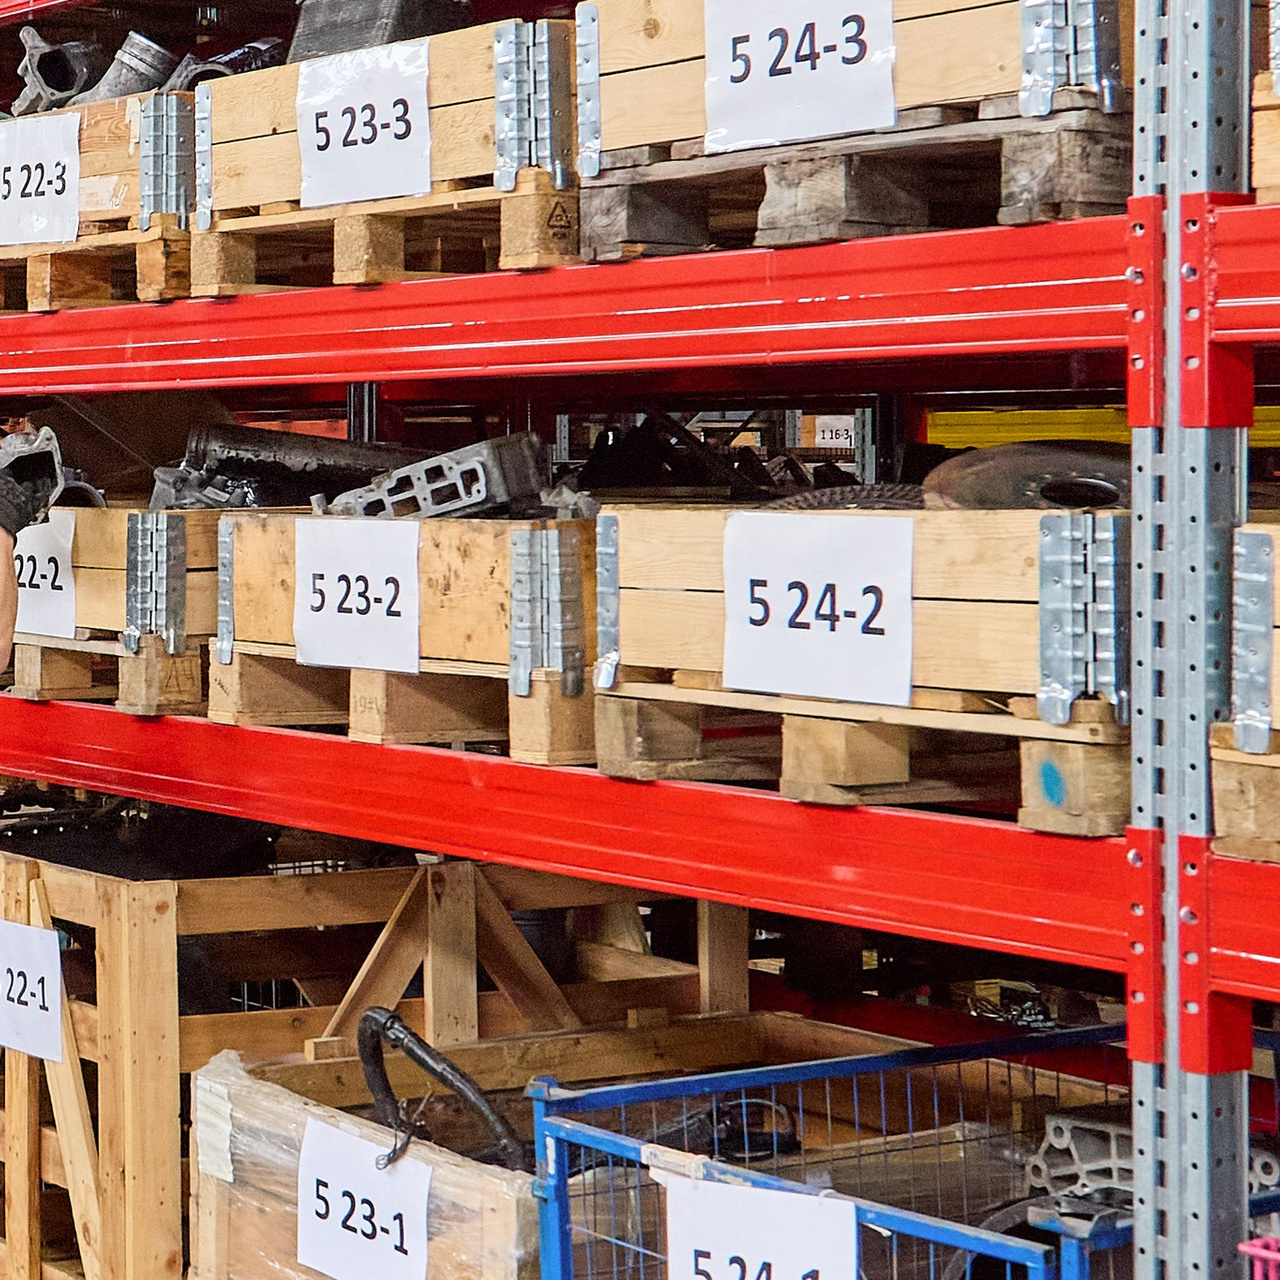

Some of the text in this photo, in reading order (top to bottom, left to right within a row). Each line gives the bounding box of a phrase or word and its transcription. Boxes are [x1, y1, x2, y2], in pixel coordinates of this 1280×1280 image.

[730, 14, 868, 84] 5 24-3
[315, 97, 412, 152] 5 23-3
[1, 161, 67, 201] 5 22-3
[14, 553, 64, 592] 22-2
[310, 573, 402, 618] 5 23-2
[749, 578, 886, 636] 5 24-2
[6, 967, 49, 1012] 22-1
[314, 1177, 409, 1256] 5 23-1
